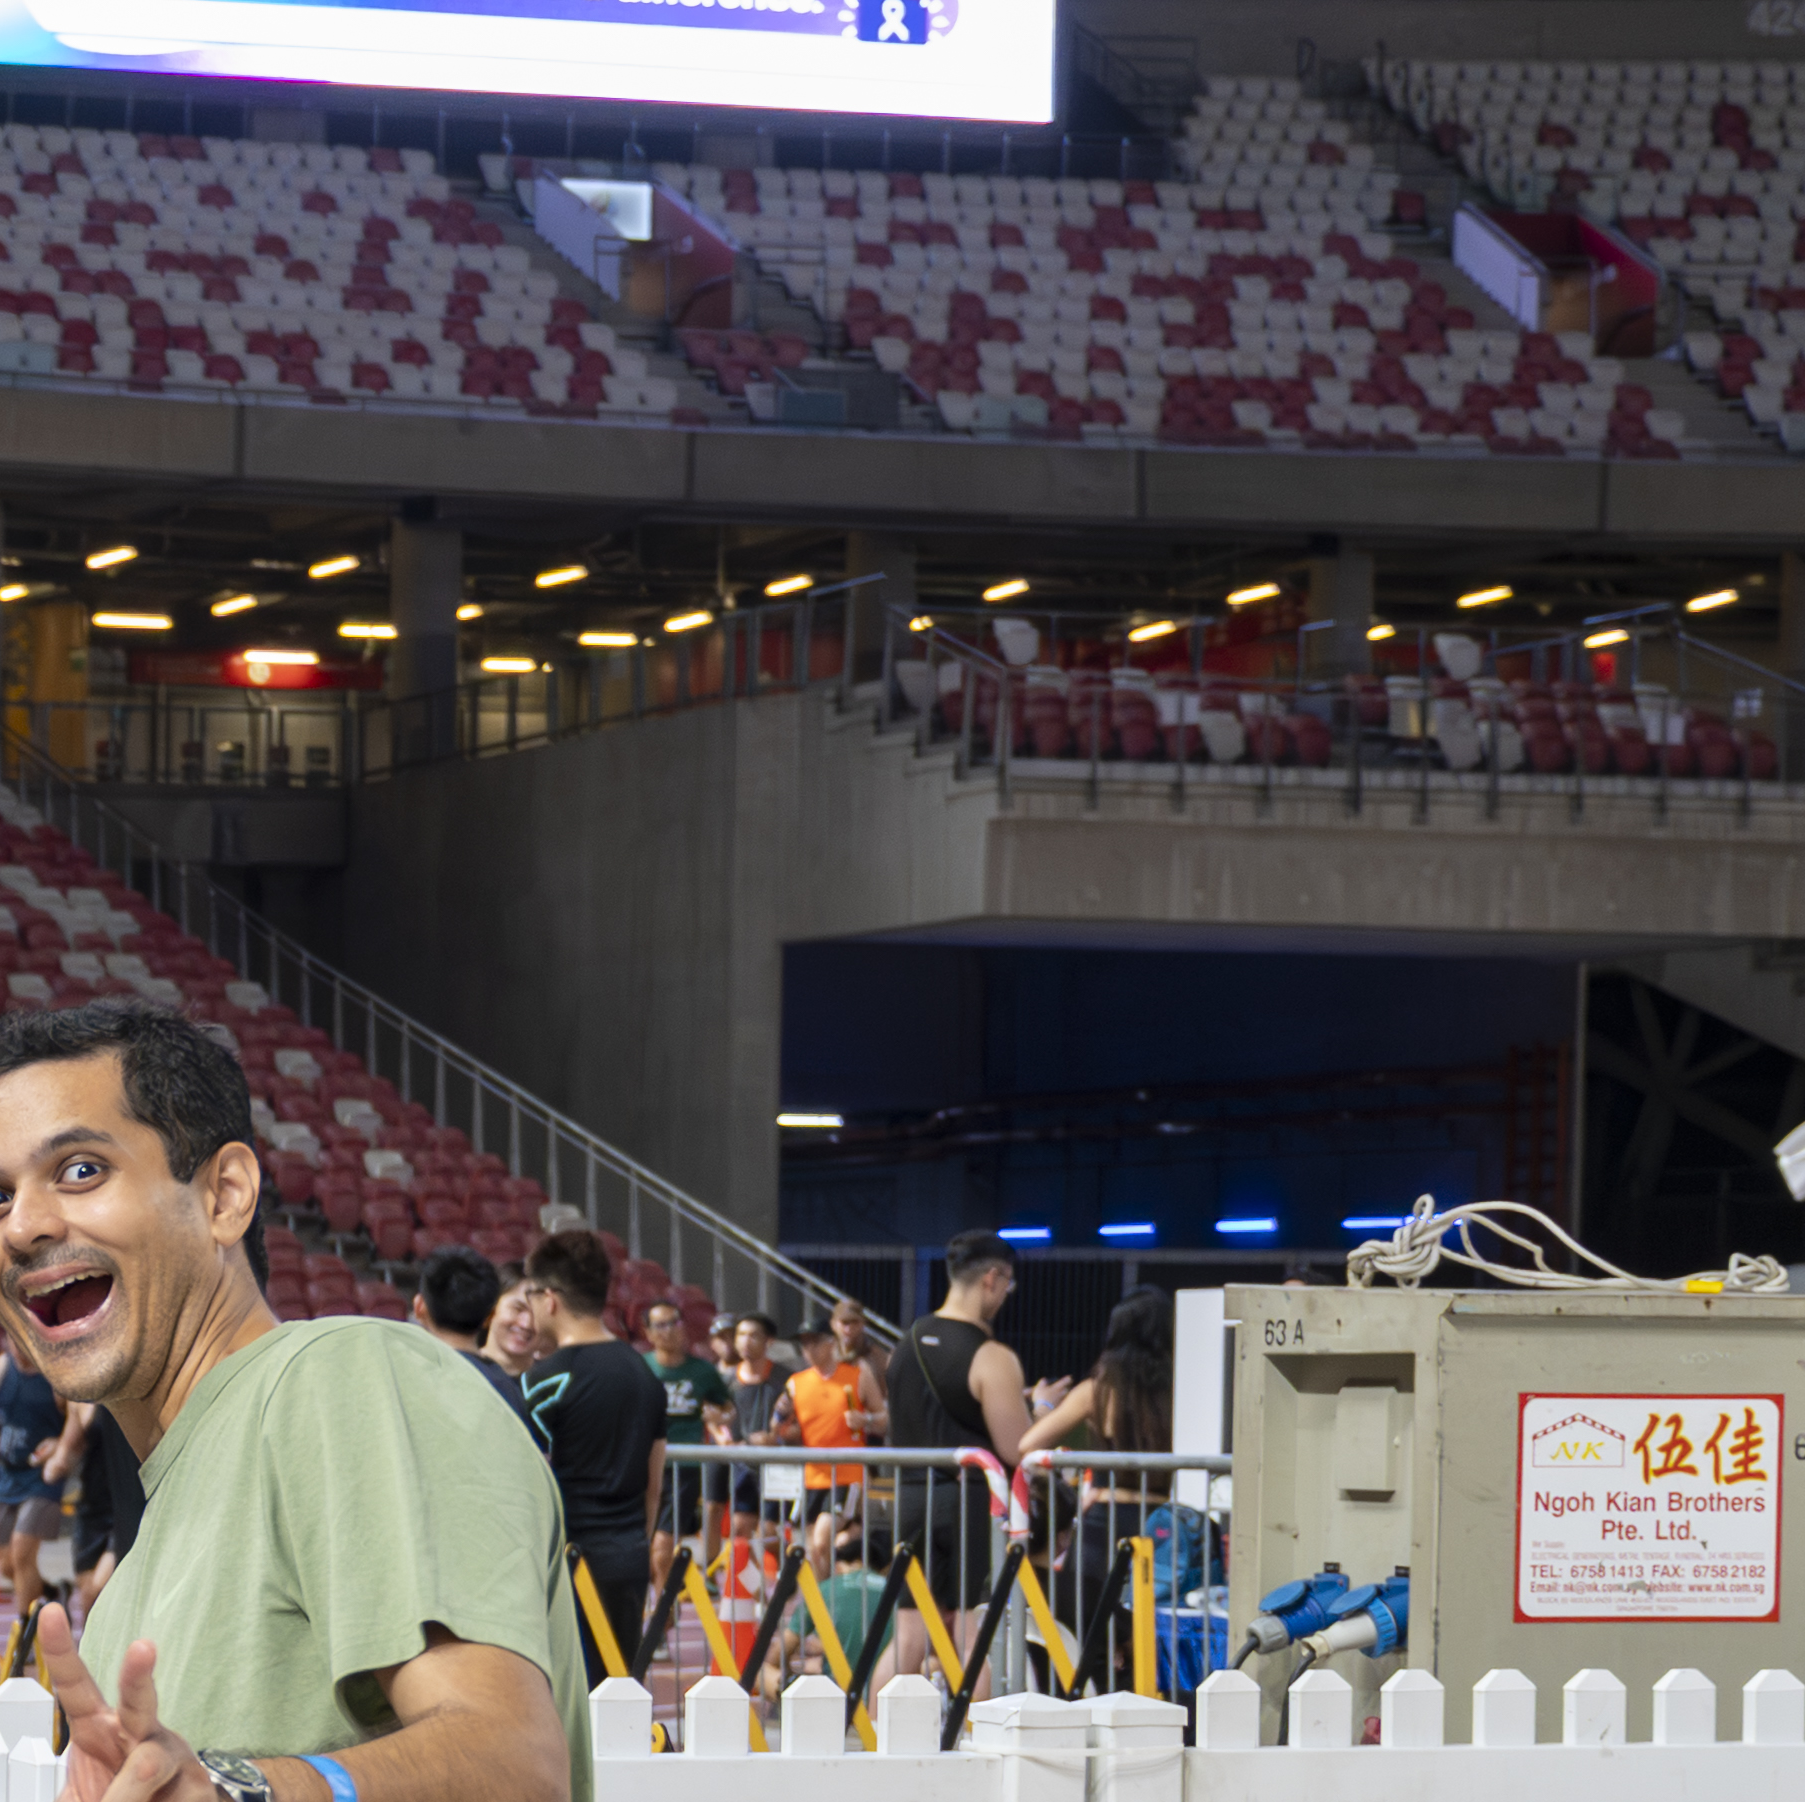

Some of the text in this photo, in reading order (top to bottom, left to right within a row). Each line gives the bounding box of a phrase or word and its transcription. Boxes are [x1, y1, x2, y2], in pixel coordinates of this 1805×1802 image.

[1265, 1318, 1304, 1346] 63 A
[1550, 1441, 1604, 1460] NK
[1632, 1406, 1768, 1485] 伍佳
[1534, 1491, 1766, 1517] Ngoh Kian Brothers
[1601, 1519, 1697, 1540] Pte. Ltd.
[1530, 1564, 1765, 1578] TEL: 6758 1413 FAX: 6758 2182
[1563, 1581, 1637, 1595] nk@nk.com.
